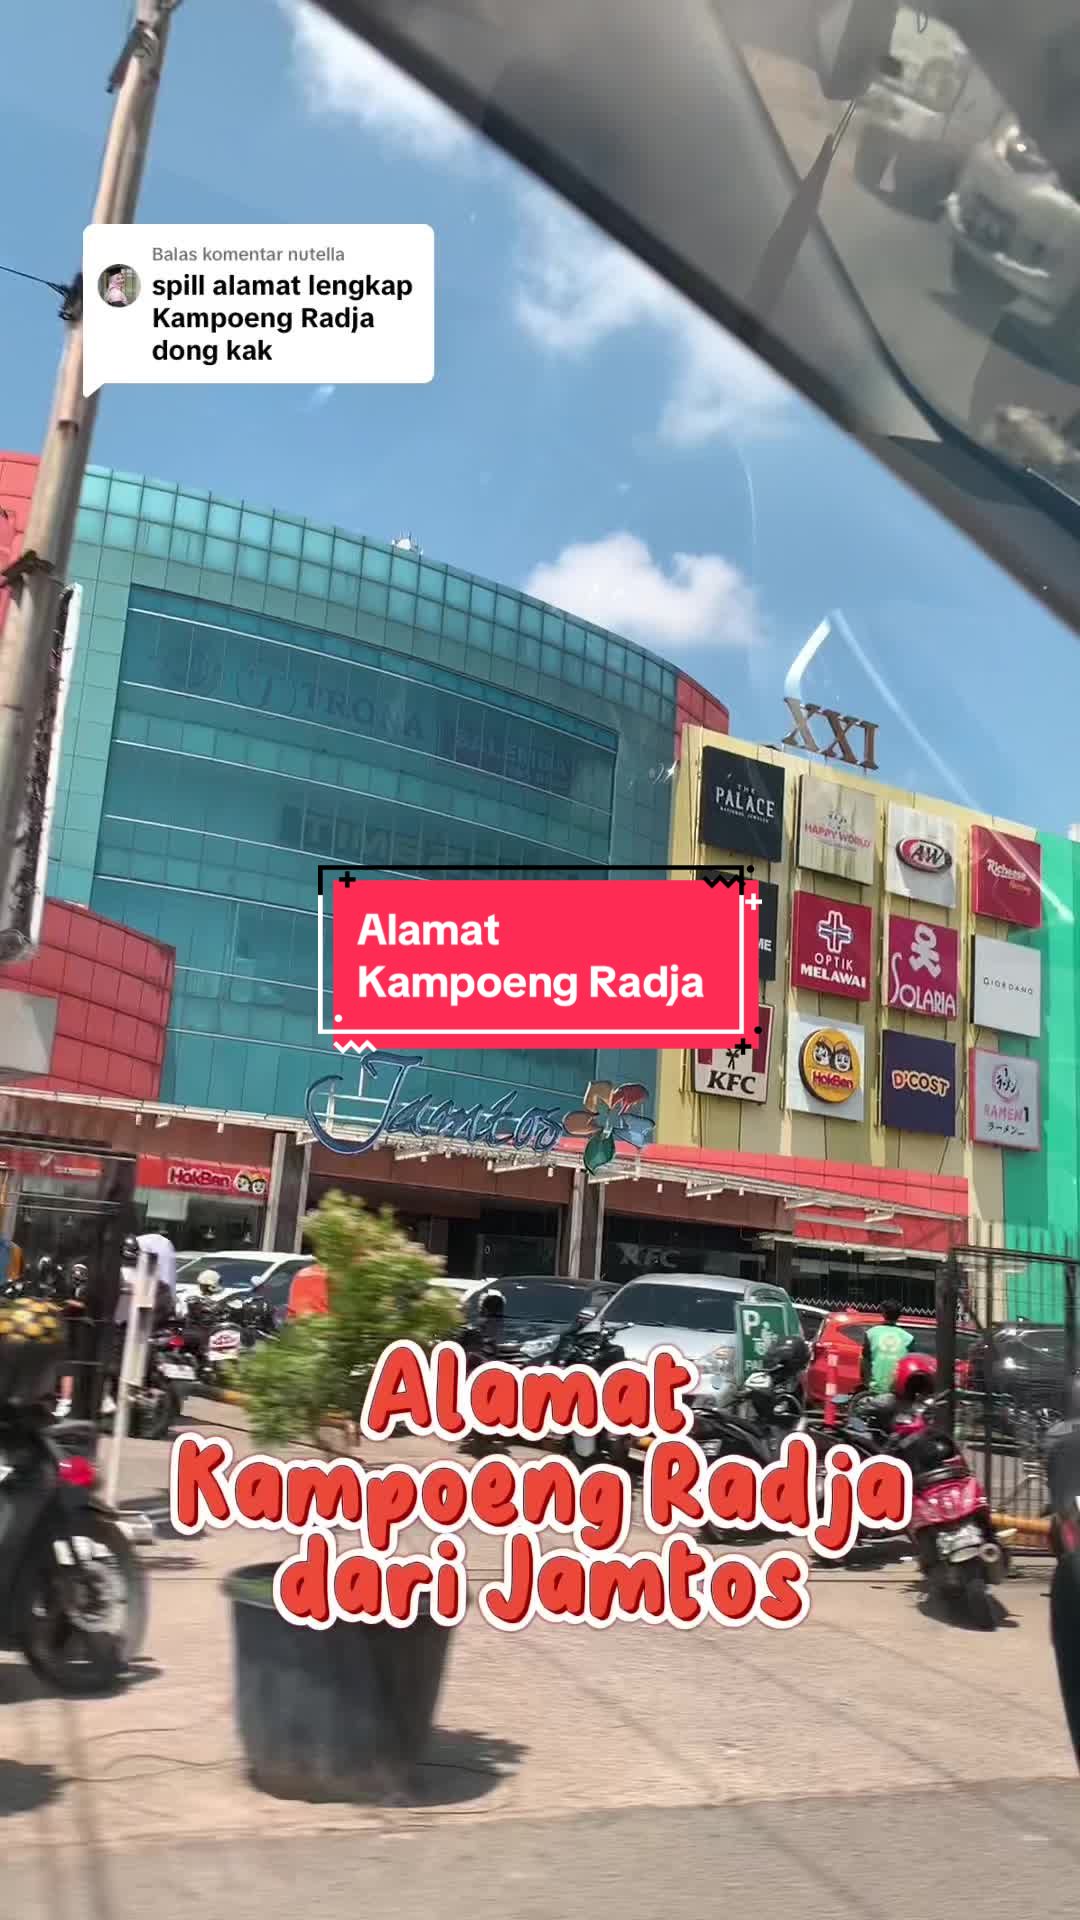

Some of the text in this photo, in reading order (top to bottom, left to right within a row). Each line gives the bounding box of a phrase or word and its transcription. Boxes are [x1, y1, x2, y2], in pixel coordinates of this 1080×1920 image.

[781, 697, 880, 770] XXI
[715, 786, 775, 819] PALACE
[804, 823, 838, 840] HAPPY
[839, 831, 871, 849] WORLD
[815, 952, 853, 971] OPTIK
[800, 963, 866, 989] MELAWAI
[890, 952, 956, 1016] SOLARIA
[983, 977, 1033, 995] GIORDANO
[707, 1070, 756, 1094] KFC
[891, 1069, 950, 1098] D'COST
[305, 1050, 562, 1155] Jamtos
[742, 1309, 761, 1336] P
